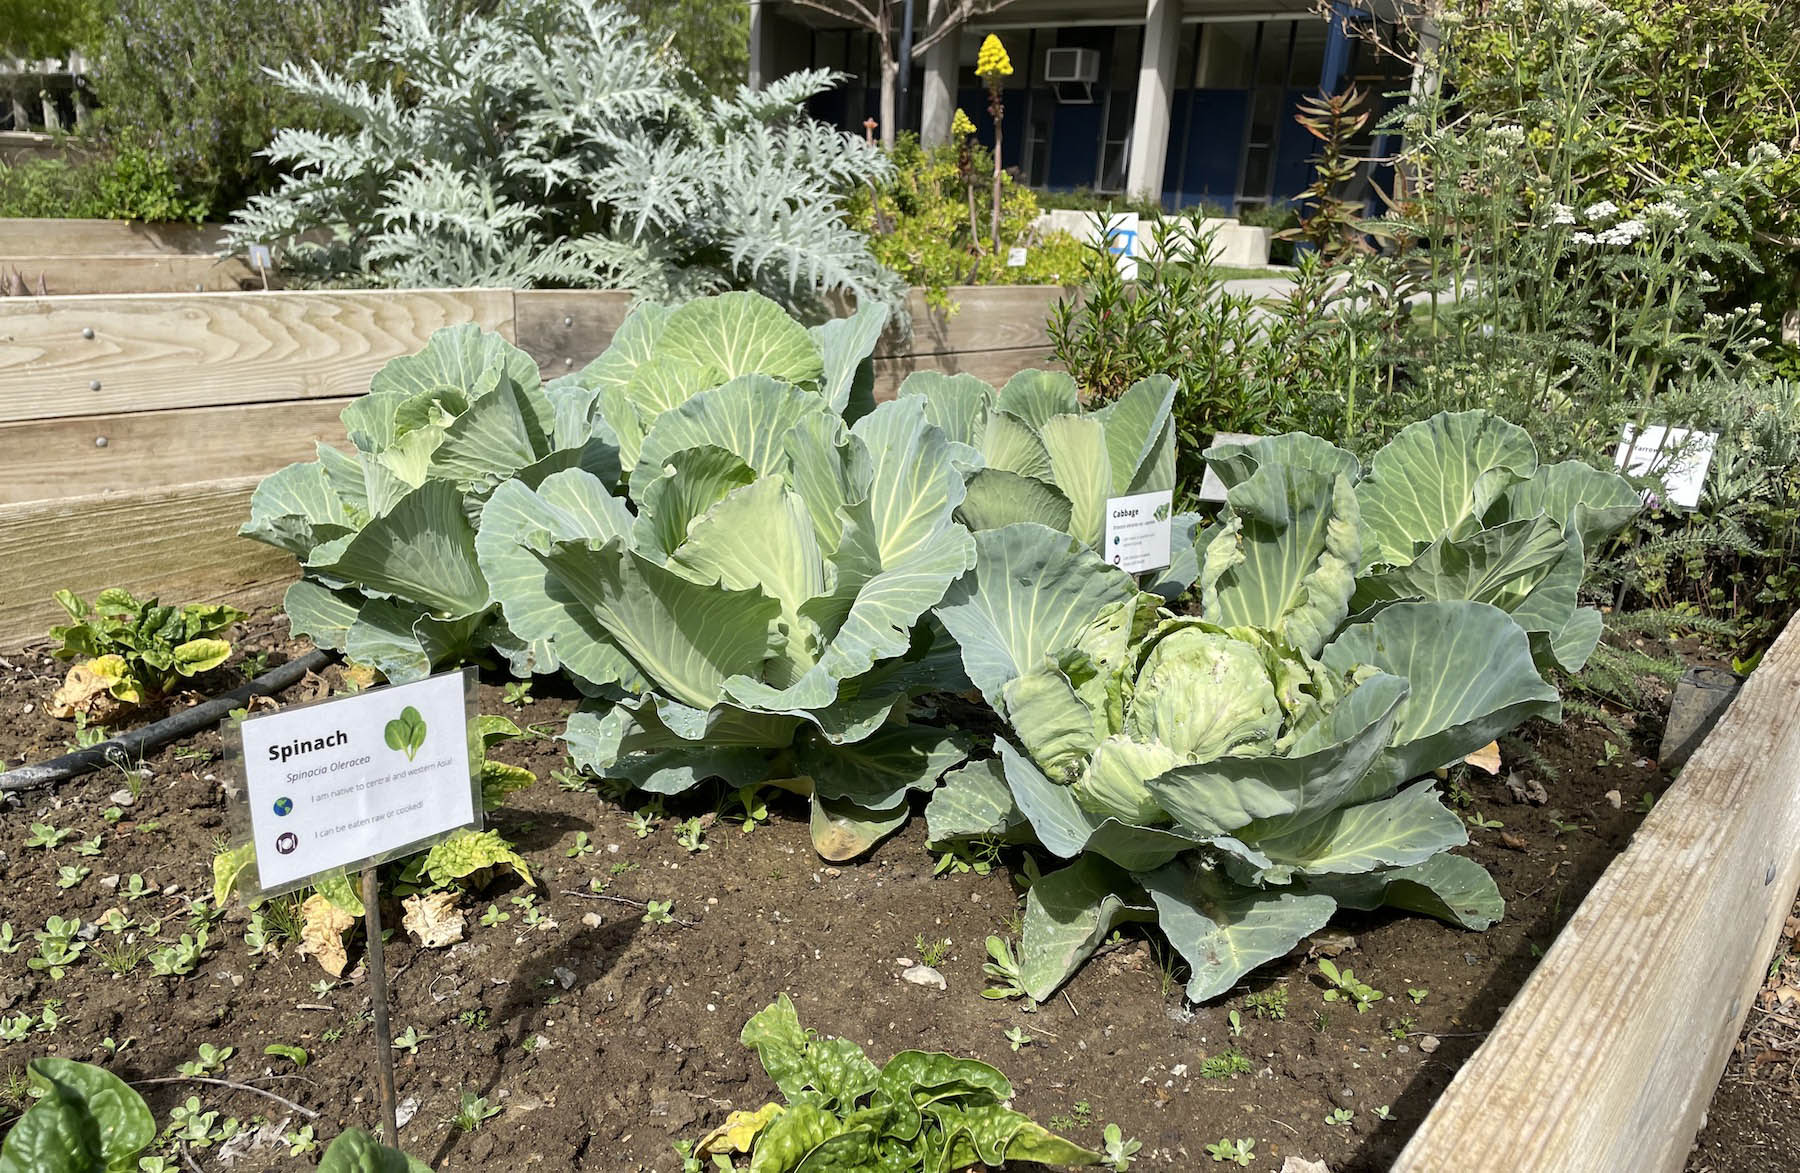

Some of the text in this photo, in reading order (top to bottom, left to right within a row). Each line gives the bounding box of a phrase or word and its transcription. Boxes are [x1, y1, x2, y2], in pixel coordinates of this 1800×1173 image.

[1113, 508, 1139, 518] Cabbage
[269, 730, 348, 763] Spinach
[286, 755, 371, 784] Spinacia Oleracea
[316, 793, 329, 802] am
[331, 786, 354, 798] native
[355, 783, 365, 791] to
[366, 773, 391, 788] central
[392, 770, 407, 780] and
[407, 763, 436, 776] western
[320, 828, 334, 838] can
[335, 824, 346, 833] be
[347, 818, 370, 830] eaten
[371, 813, 385, 823] raw
[386, 810, 394, 818] or
[396, 800, 424, 815] cooked!
